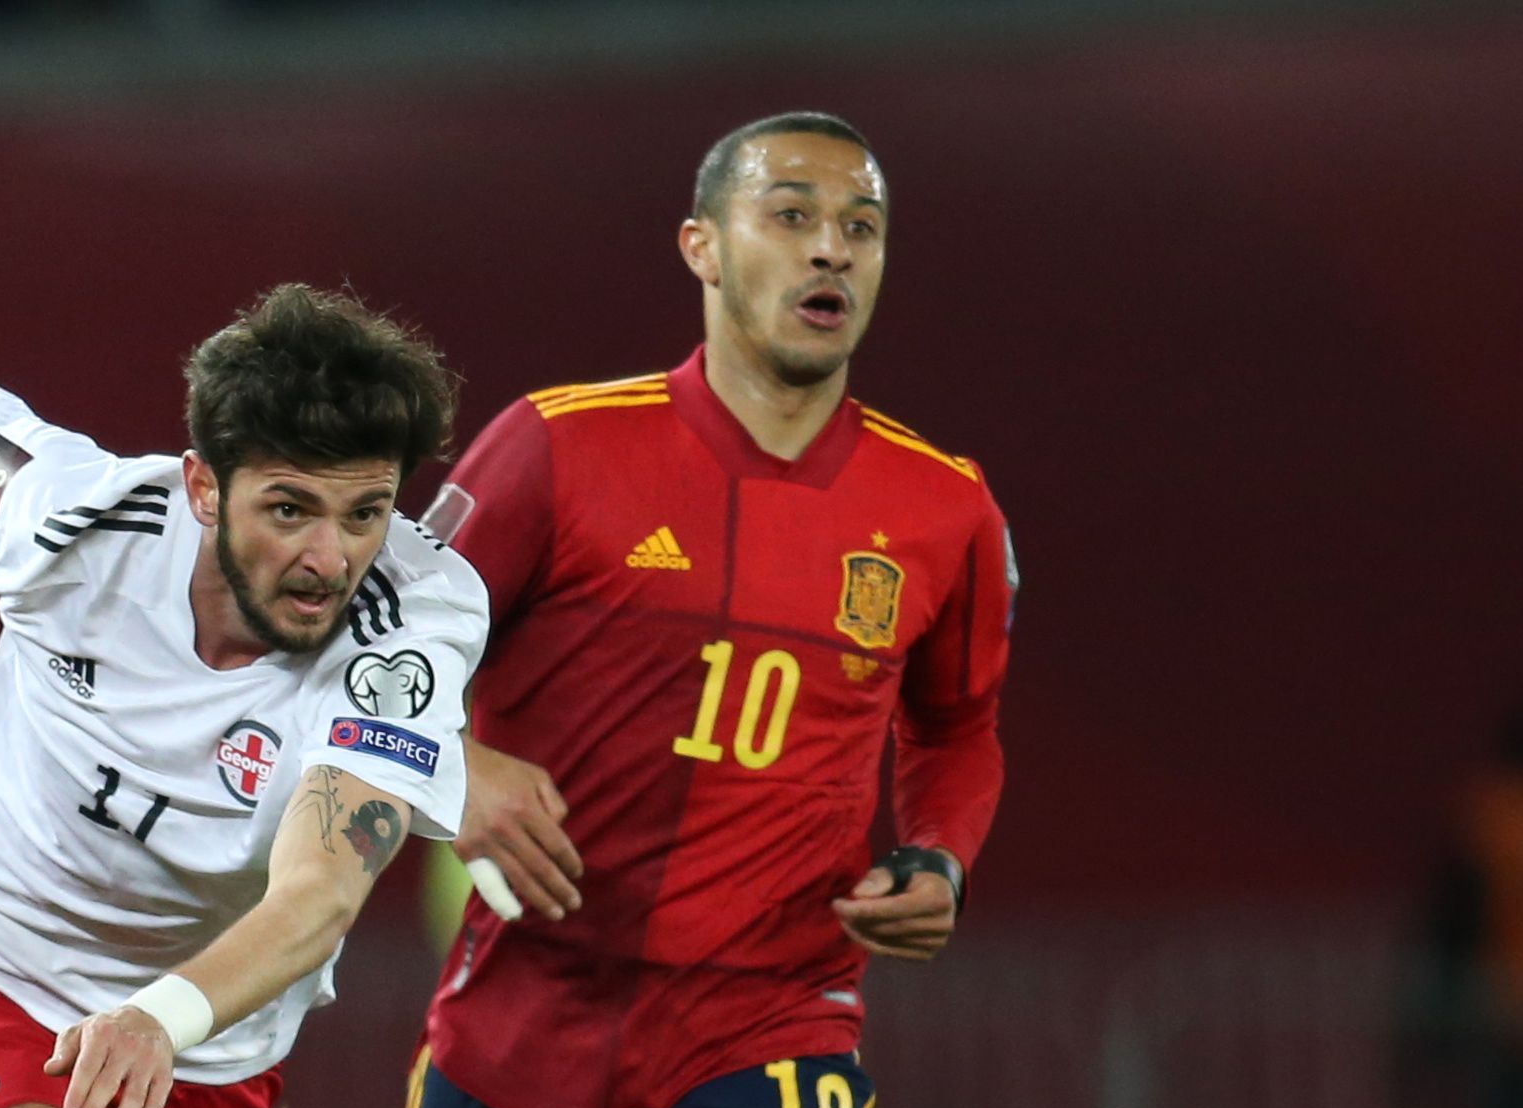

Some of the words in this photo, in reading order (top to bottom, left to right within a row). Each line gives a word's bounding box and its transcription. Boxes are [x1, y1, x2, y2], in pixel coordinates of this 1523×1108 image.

[625, 552, 691, 571] adidas
[48, 658, 95, 699] adidas
[672, 640, 801, 770] 10
[362, 728, 438, 767] RESPECT
